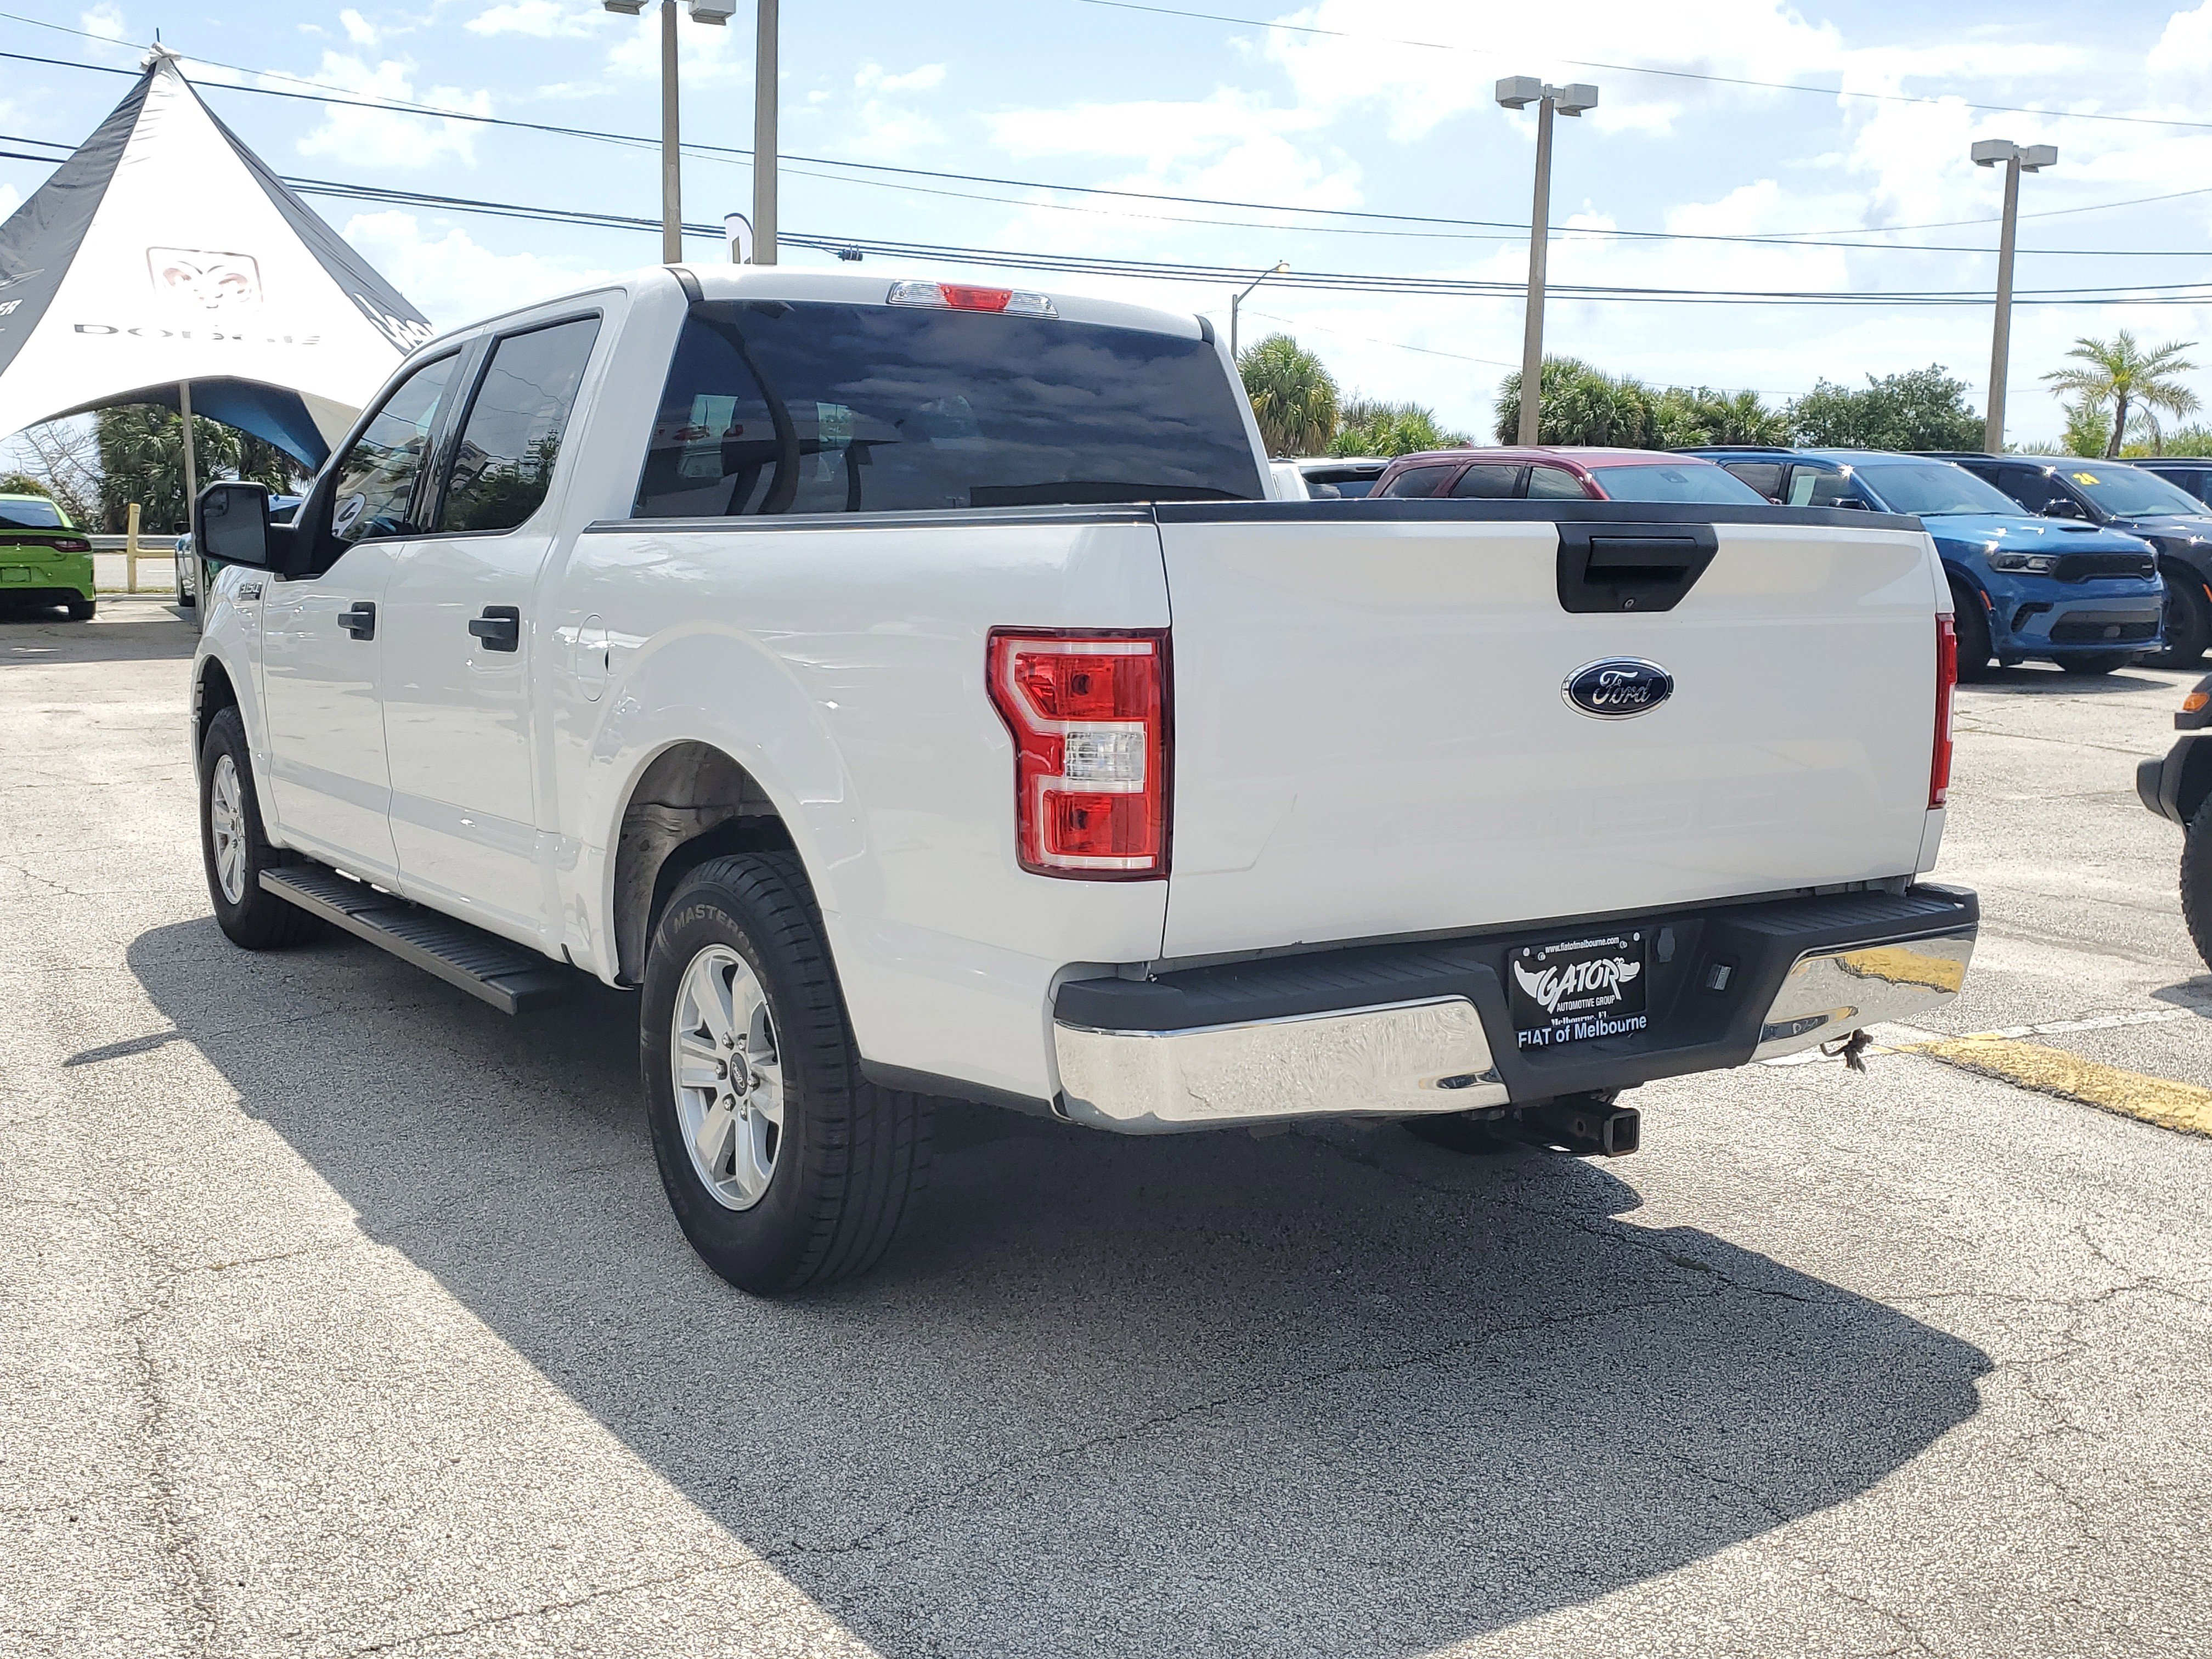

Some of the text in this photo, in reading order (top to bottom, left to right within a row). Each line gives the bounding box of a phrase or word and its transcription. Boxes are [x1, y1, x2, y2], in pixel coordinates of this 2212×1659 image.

[1593, 670, 1652, 705] Ford
[1545, 936, 1619, 954] www.fiatofmelbourne.com
[1537, 958, 1622, 1014] GATOR
[1556, 994, 1615, 1012] AUTOMOTIVE GROUP
[1517, 1015, 1647, 1048] FIAT of Melbourne
